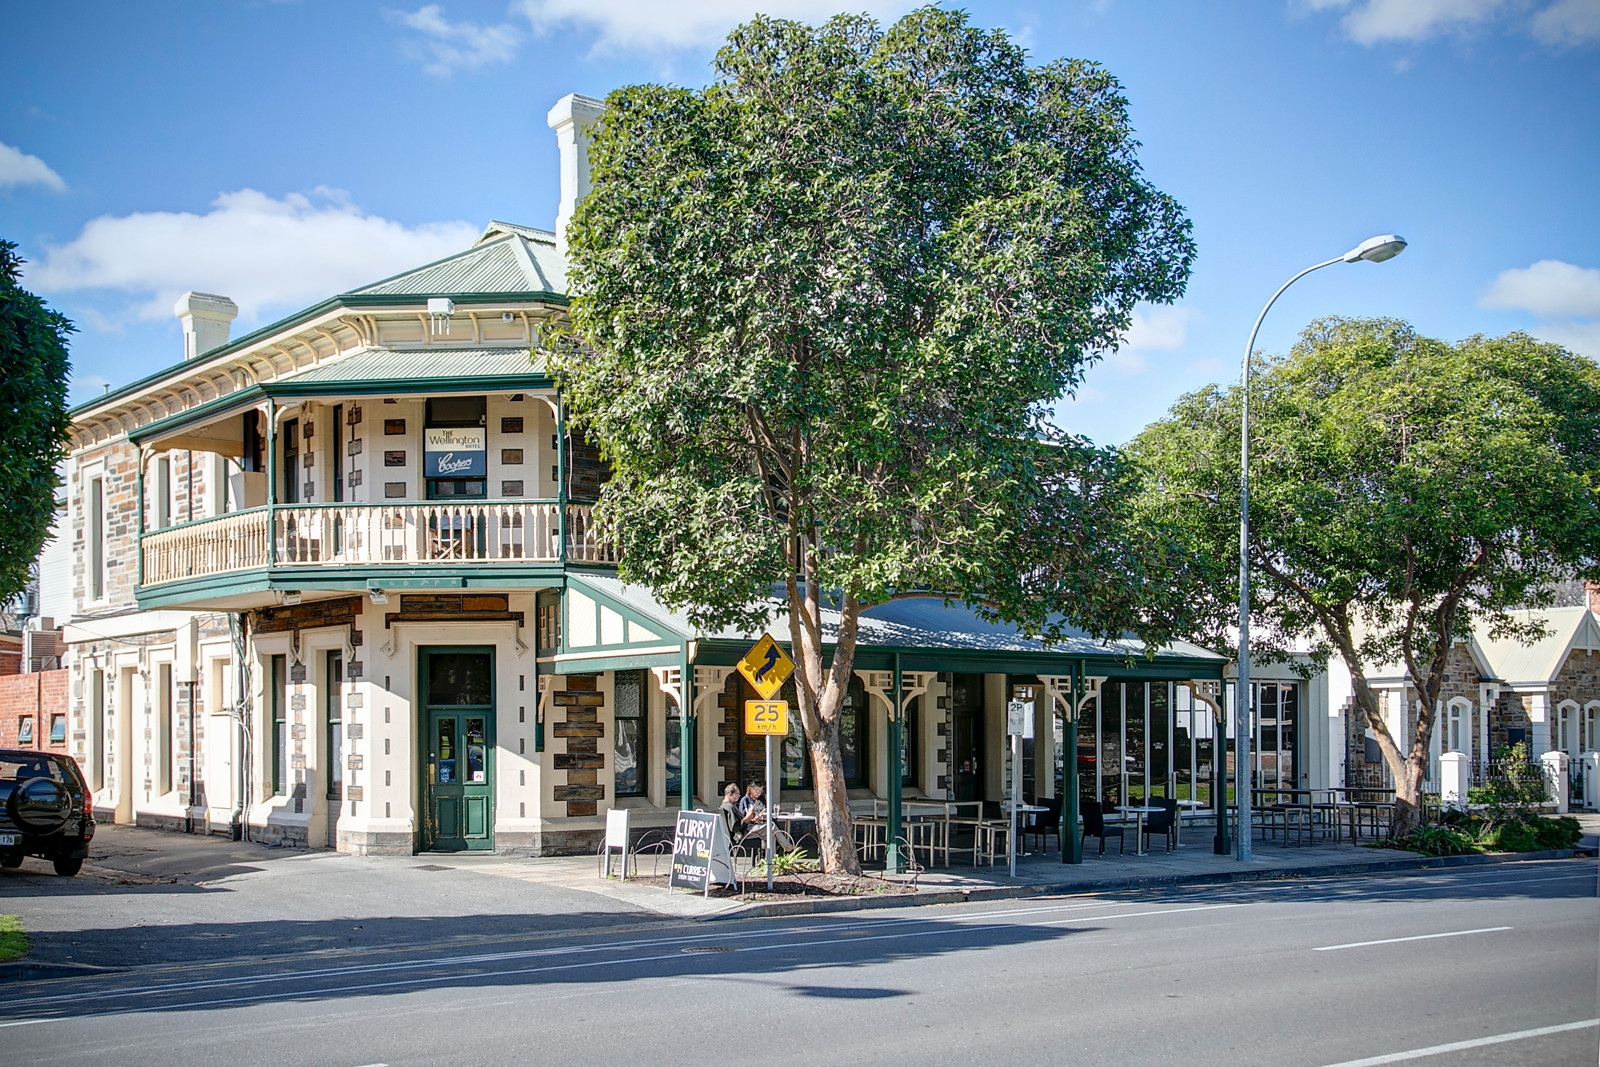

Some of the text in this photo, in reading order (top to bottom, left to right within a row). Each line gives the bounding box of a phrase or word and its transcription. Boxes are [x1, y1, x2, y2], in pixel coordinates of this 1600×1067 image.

[429, 434, 480, 446] Wellington
[438, 452, 472, 474] Coopers
[754, 705, 779, 722] 25
[677, 818, 712, 839] CURRY
[674, 837, 696, 856] DAY
[683, 864, 706, 876] CURRIES
